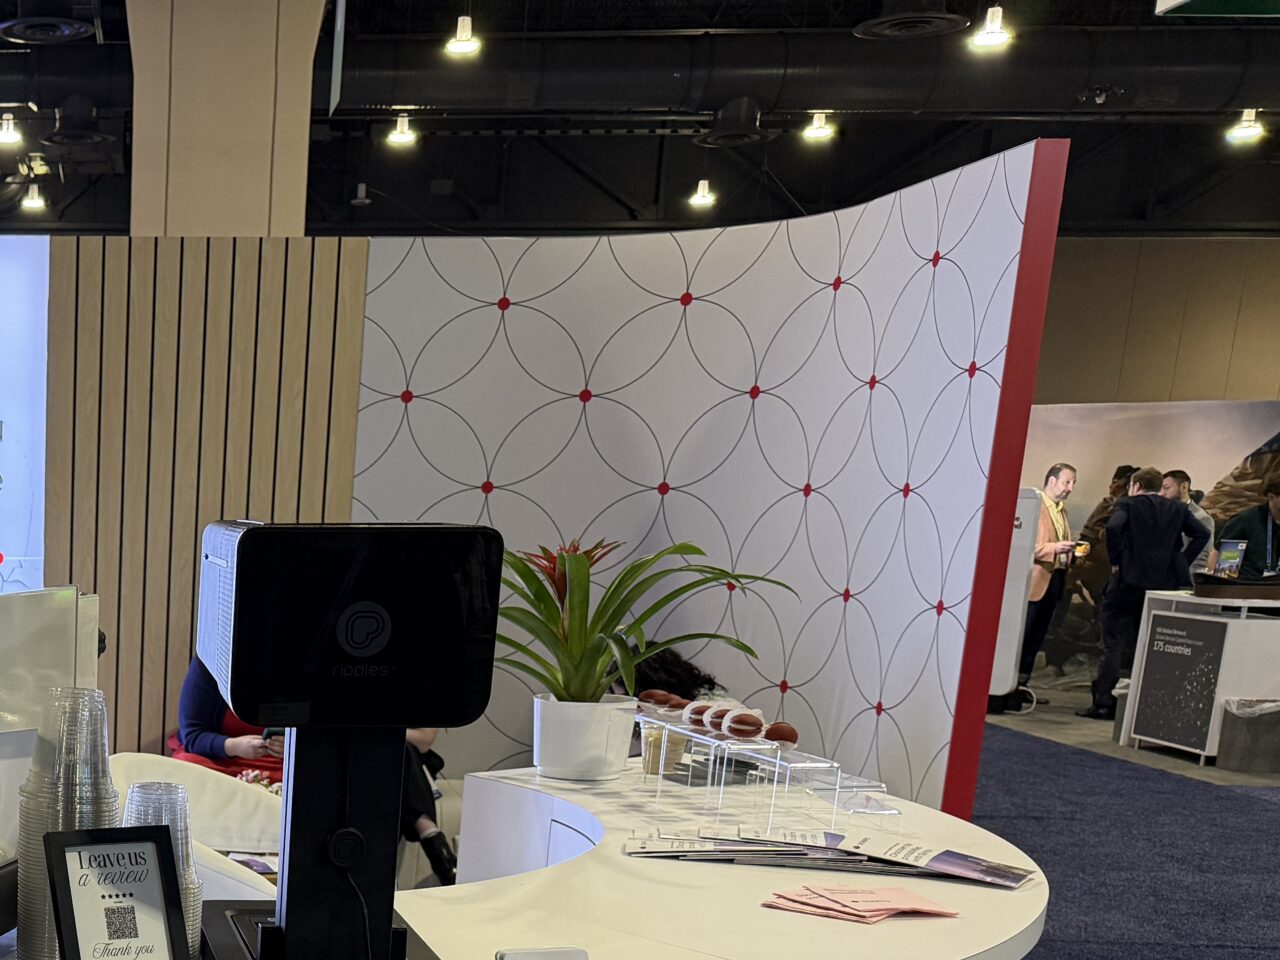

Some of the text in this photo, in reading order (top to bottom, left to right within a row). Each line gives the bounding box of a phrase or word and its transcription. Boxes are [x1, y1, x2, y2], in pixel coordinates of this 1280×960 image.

[1153, 640, 1165, 651] 175
[78, 850, 147, 869] Leave us
[78, 866, 150, 887] a review
[92, 941, 155, 960] Thank you
